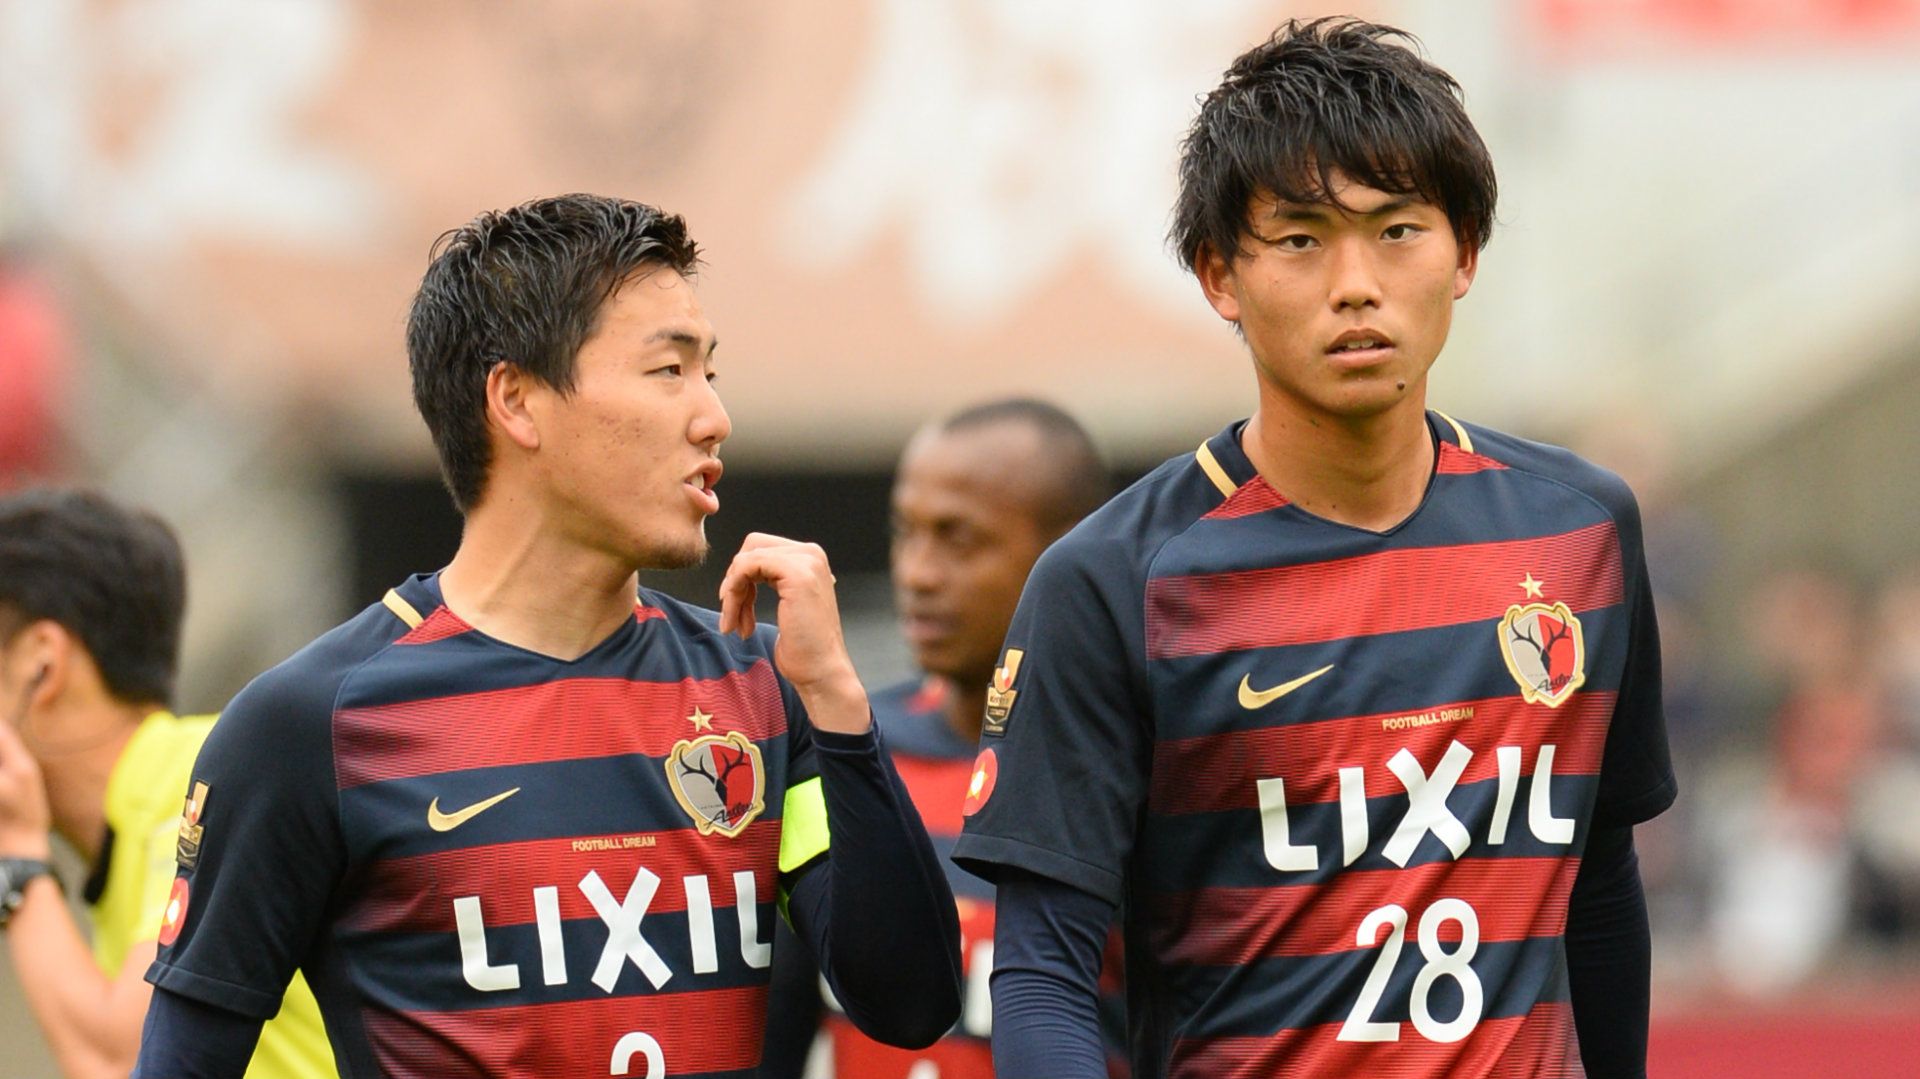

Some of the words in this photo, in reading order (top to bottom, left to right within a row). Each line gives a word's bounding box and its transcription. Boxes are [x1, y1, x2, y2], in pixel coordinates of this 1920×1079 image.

[1382, 711, 1440, 731] FOOTBALL
[1441, 707, 1474, 721] DREAM
[572, 838, 622, 852] FOOTBALL
[622, 836, 656, 848] DREAM
[1257, 739, 1575, 871] LIXIL
[453, 866, 771, 993] LIXIL
[1336, 898, 1483, 1042] 28
